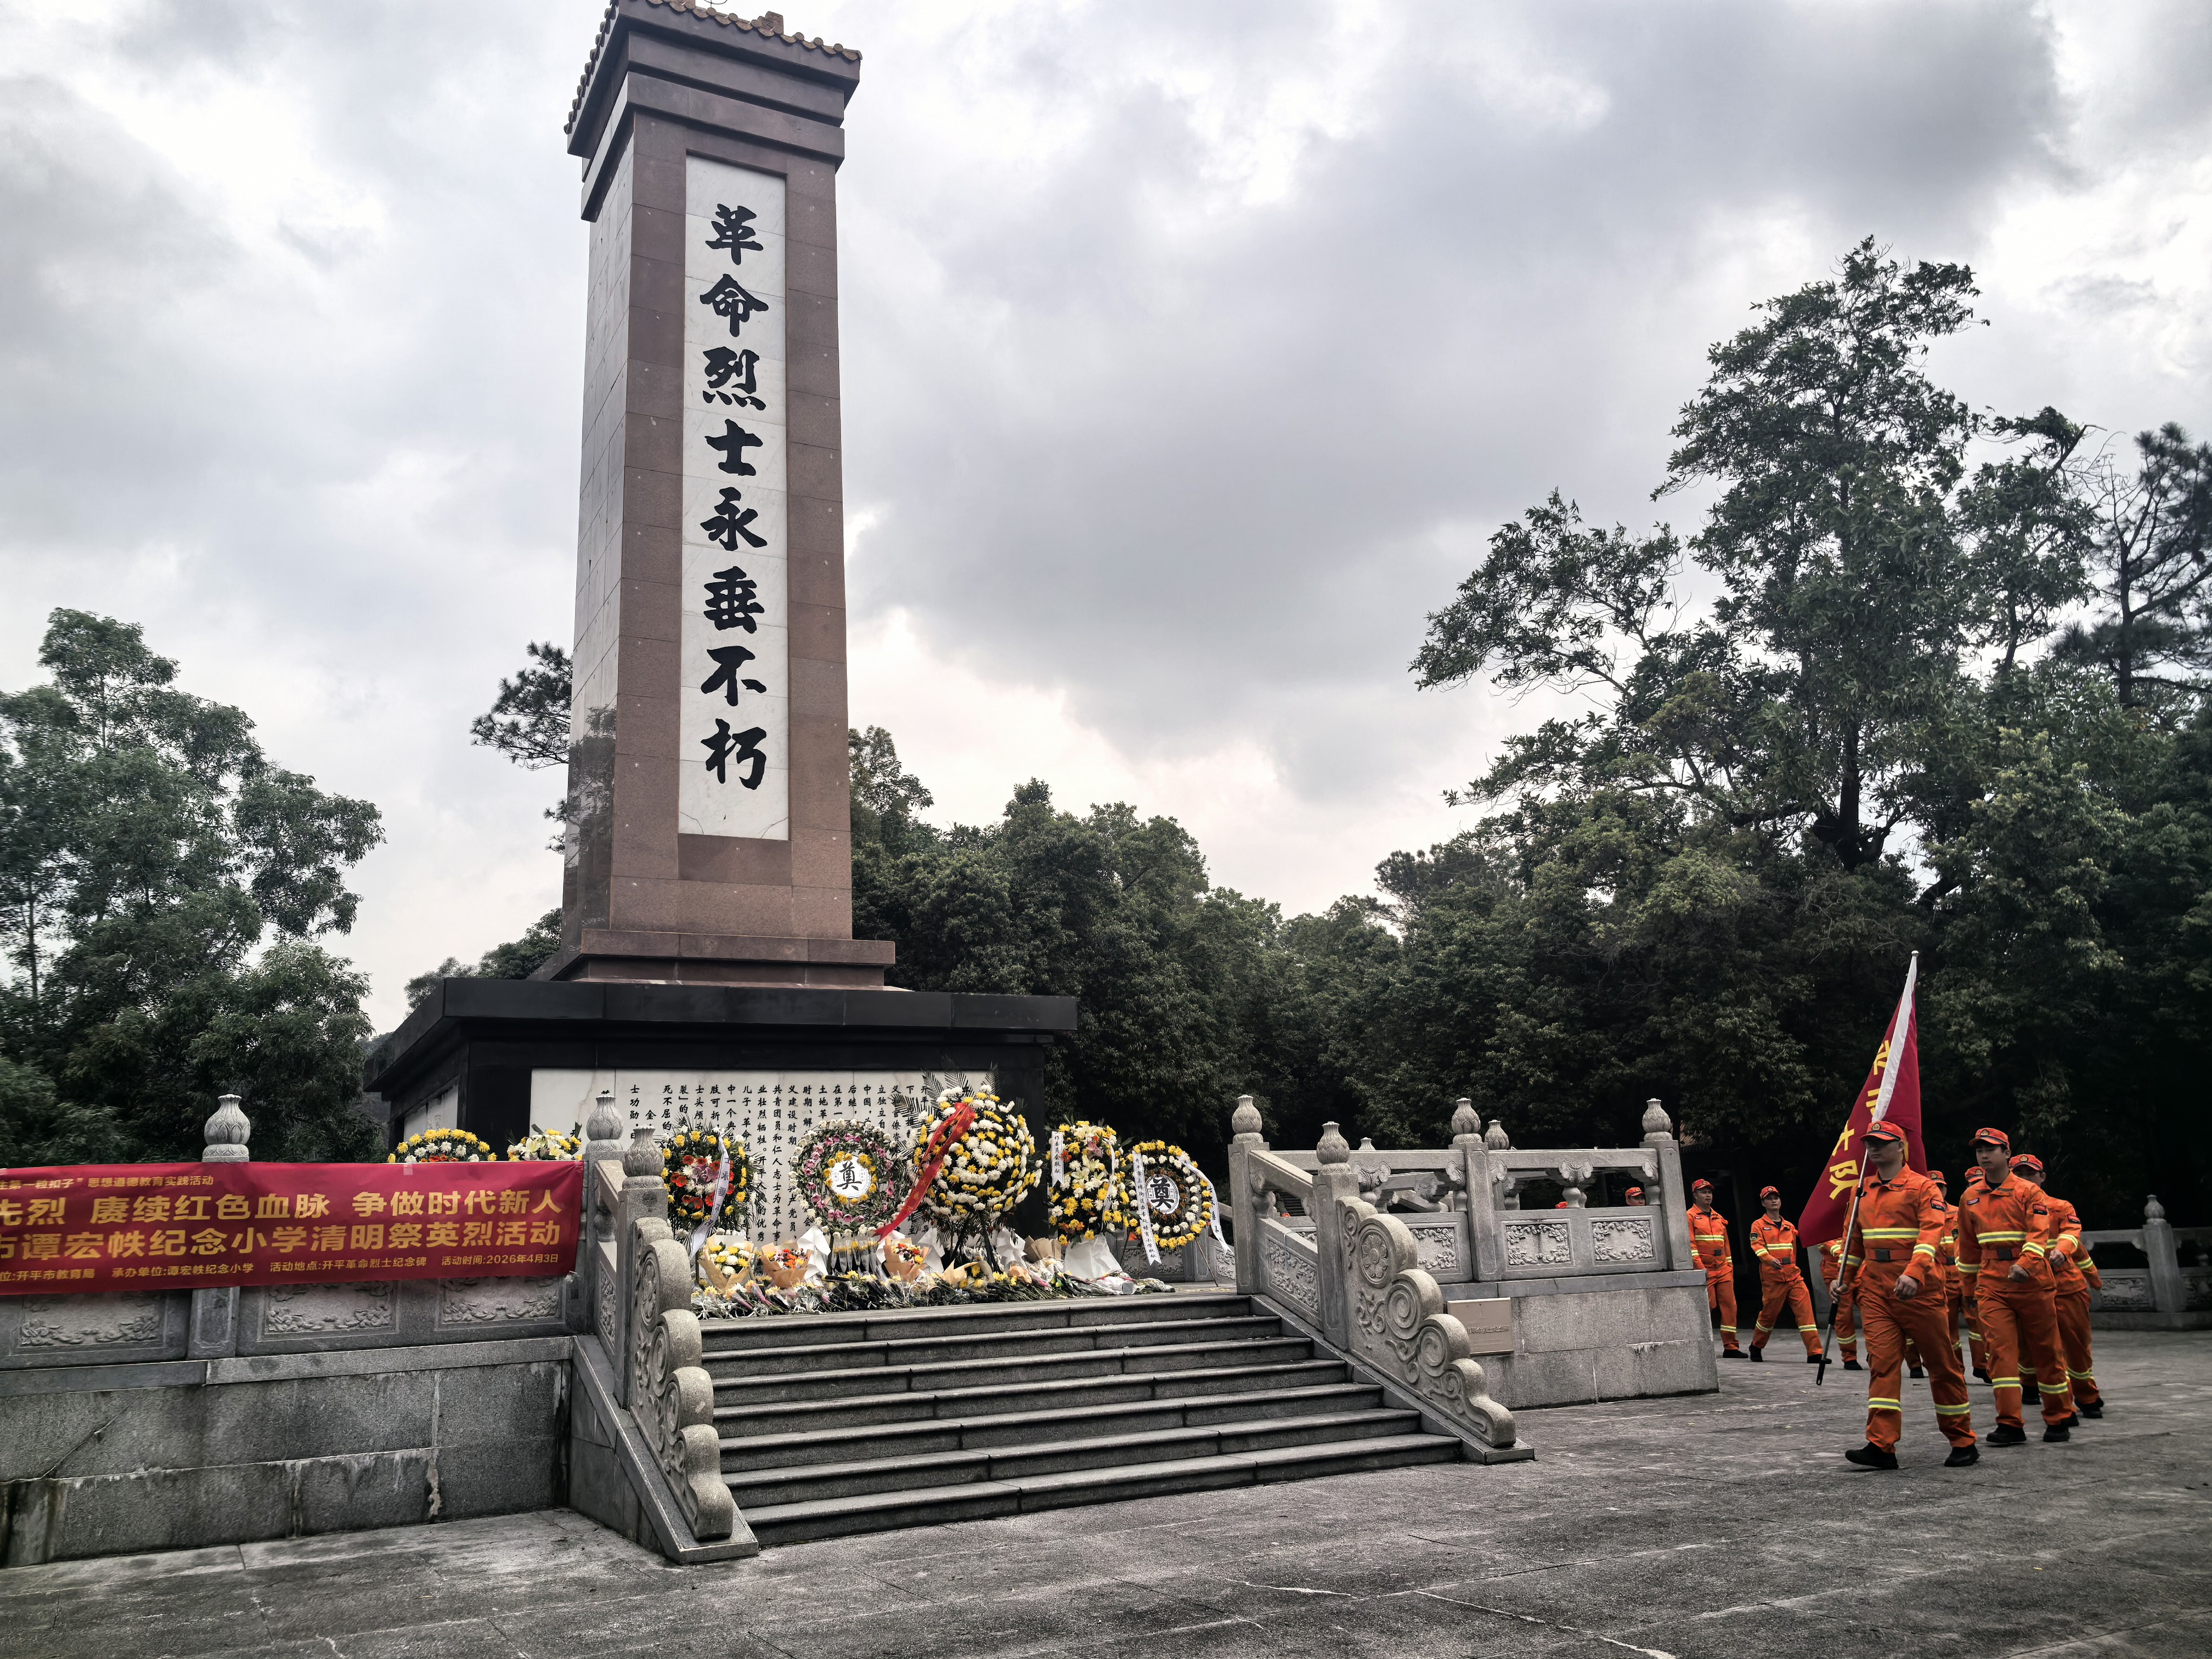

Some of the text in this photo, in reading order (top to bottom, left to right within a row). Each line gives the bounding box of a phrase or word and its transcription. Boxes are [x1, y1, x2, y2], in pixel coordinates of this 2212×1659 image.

[699, 203, 768, 790] 革命烈士永垂不朽
[833, 1084, 843, 1115] 在第一
[877, 1084, 887, 1129] 立独立自
[772, 1084, 783, 1242] 共青团员和仁人志士为革命事
[837, 1161, 862, 1191] 奠
[87, 1175, 214, 1188] 思想道德教育实践活动
[1150, 1177, 1175, 1209] 奠
[90, 1193, 331, 1225] 赓续红色血脉
[352, 1189, 563, 1217] 争做时代新人
